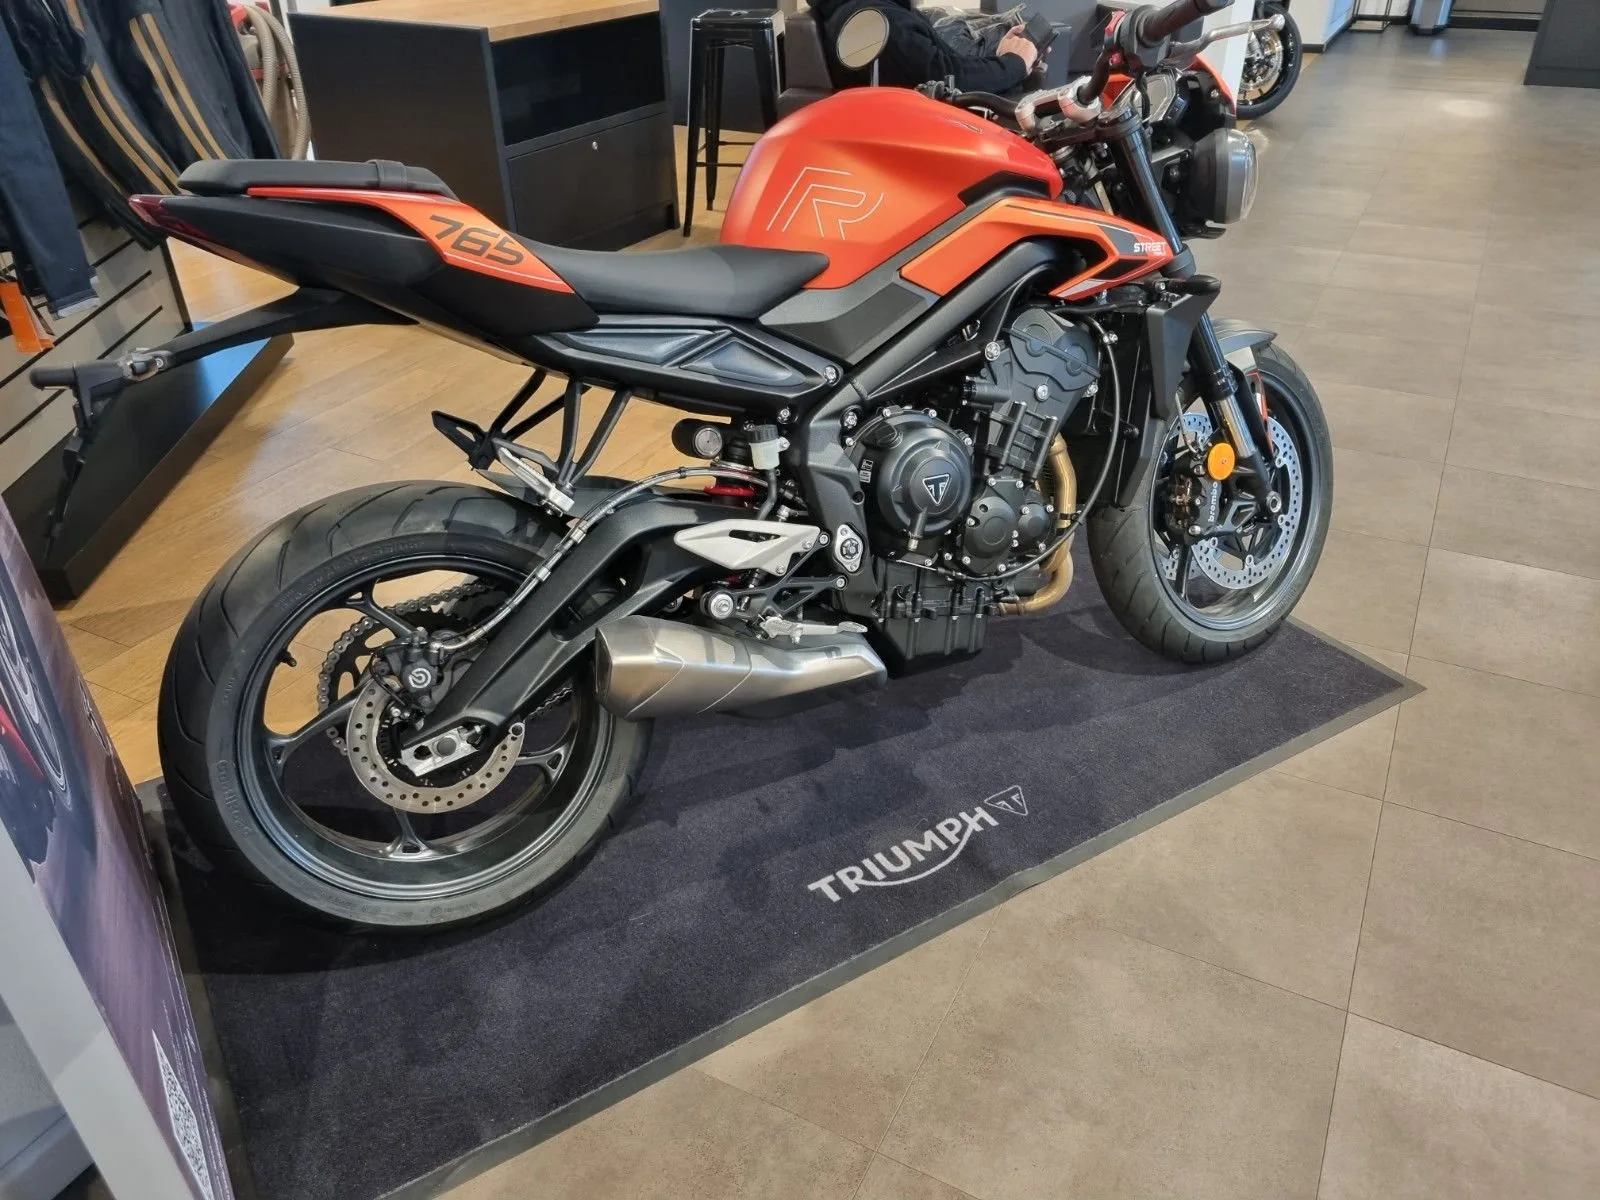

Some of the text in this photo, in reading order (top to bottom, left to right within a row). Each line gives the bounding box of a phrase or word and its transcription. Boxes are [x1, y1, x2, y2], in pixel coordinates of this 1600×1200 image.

[430, 214, 524, 266] 765
[1133, 242, 1167, 253] STREET
[1207, 481, 1219, 523] brembo
[807, 806, 999, 902] TRIUMPH
